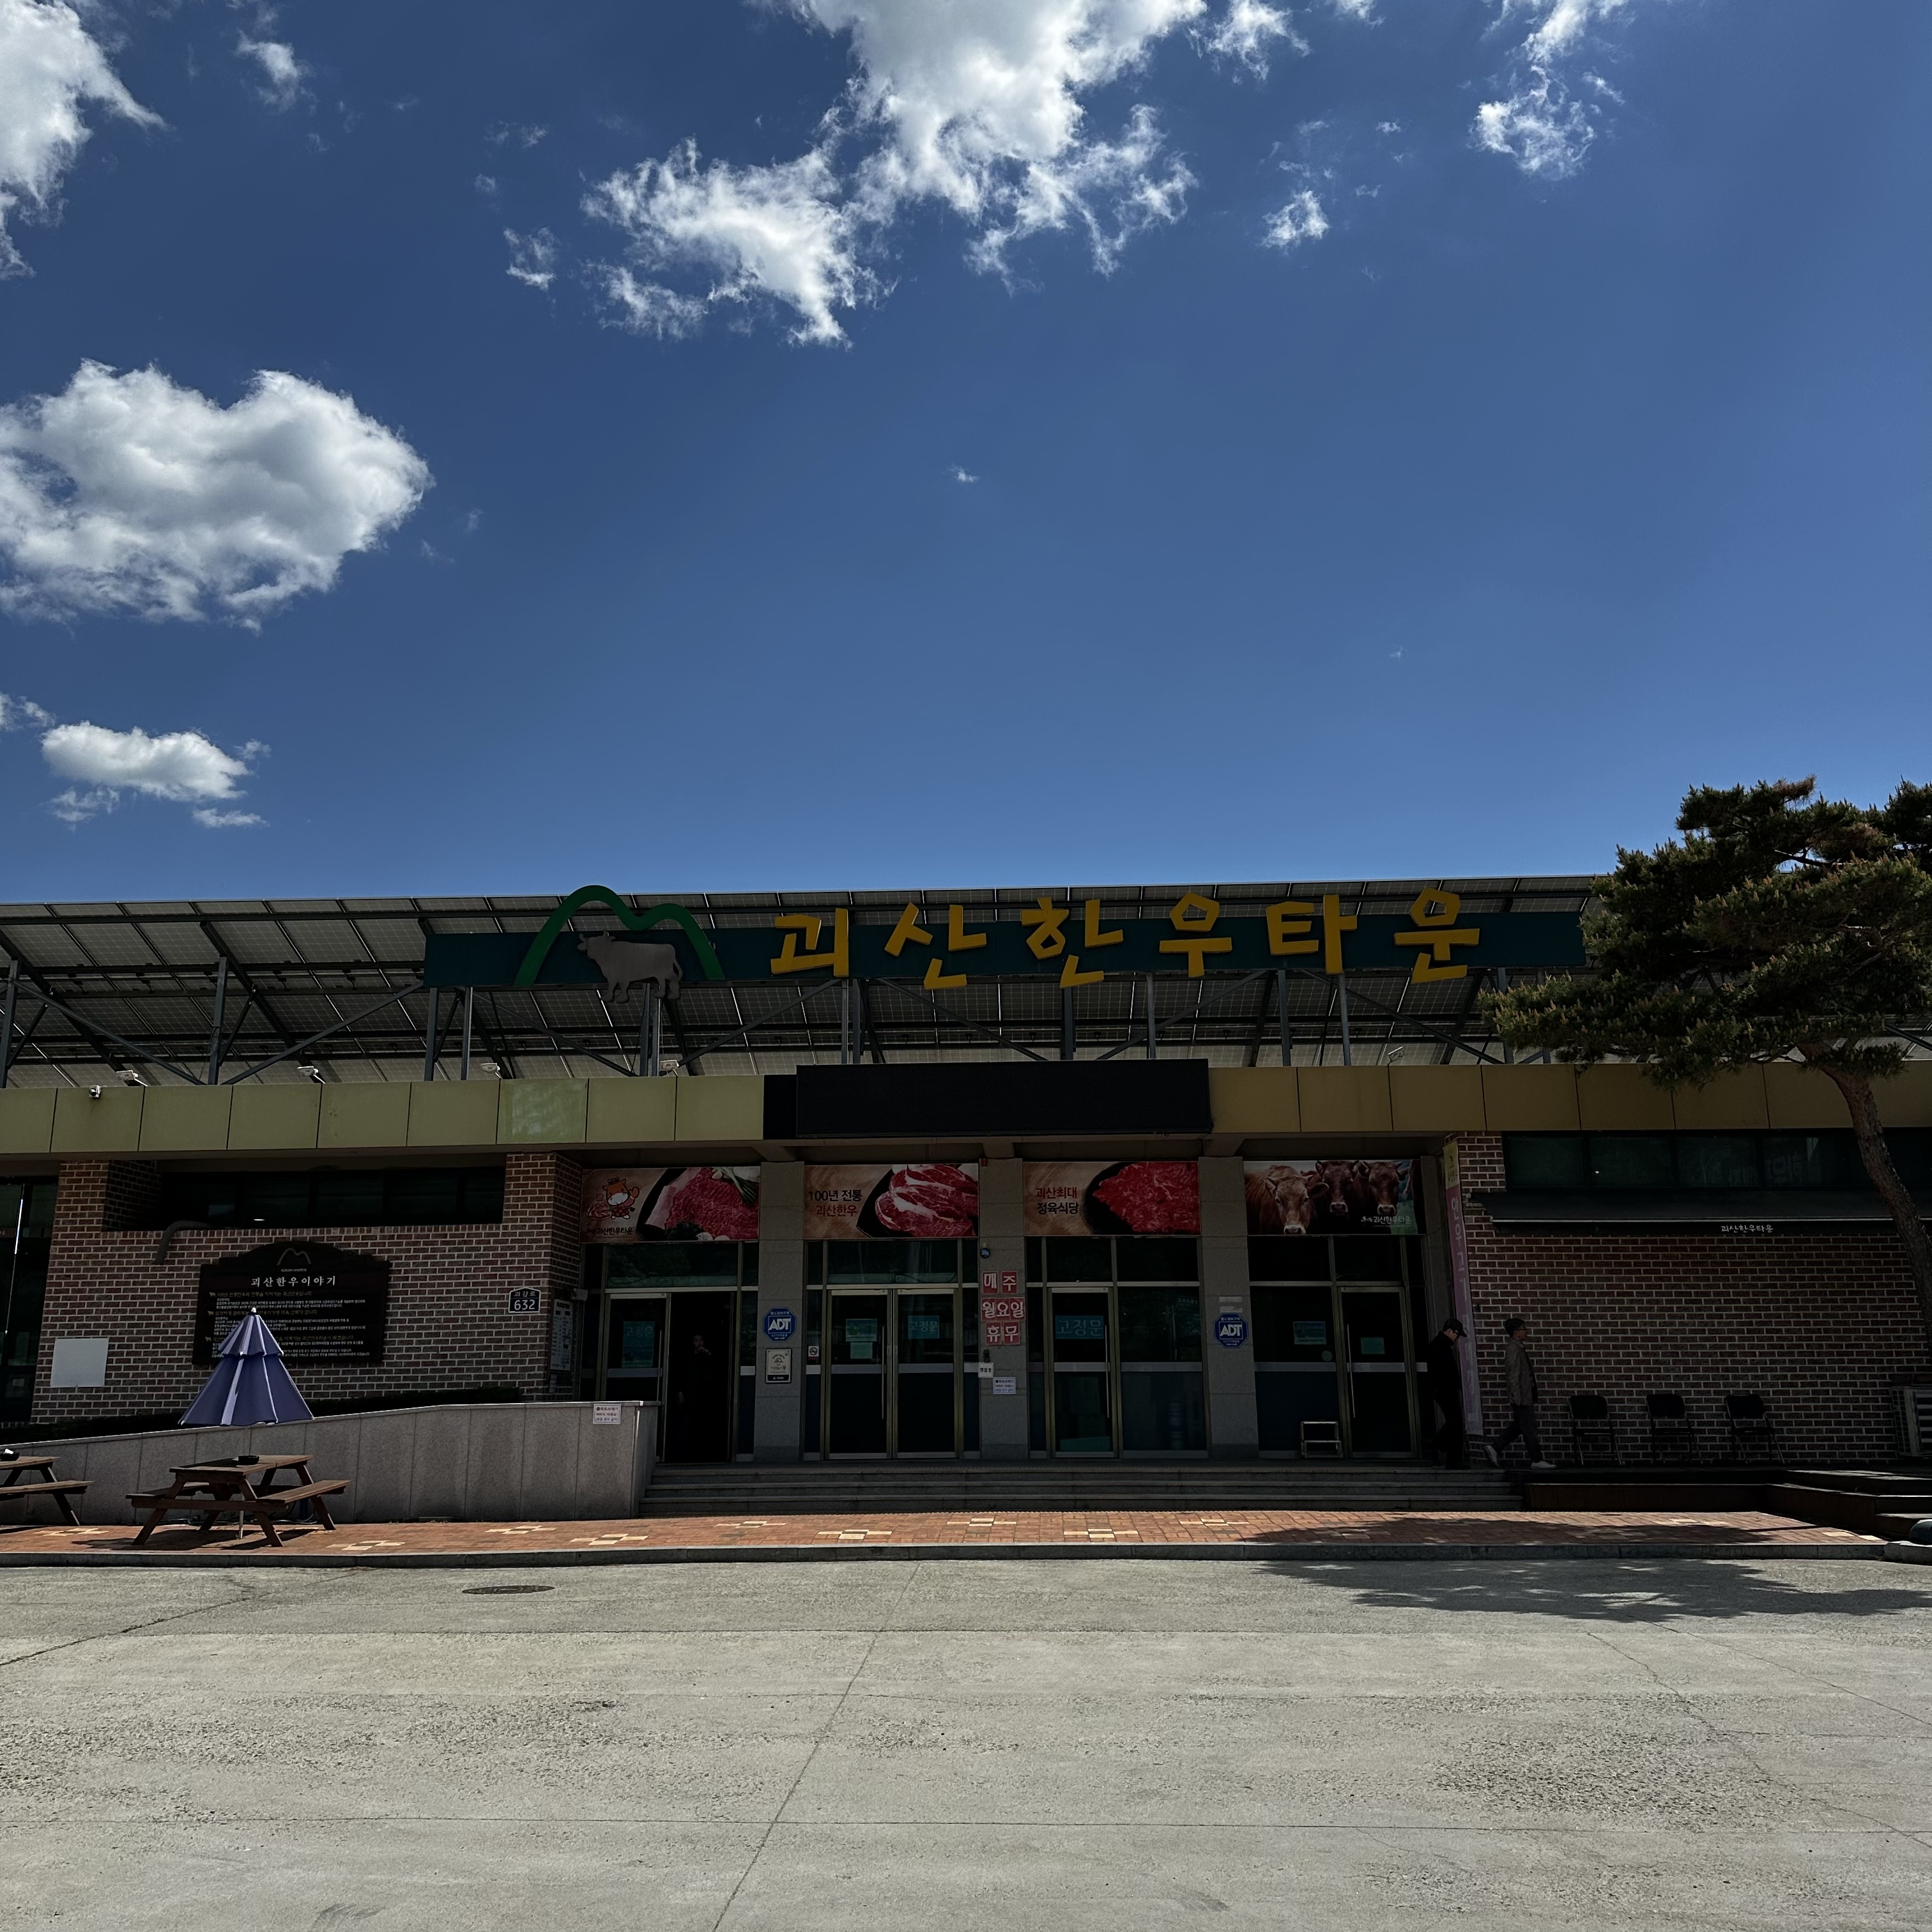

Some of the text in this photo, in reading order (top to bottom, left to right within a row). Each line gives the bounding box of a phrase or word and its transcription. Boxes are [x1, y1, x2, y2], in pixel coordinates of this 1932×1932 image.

[770, 887, 1480, 989] 괴산한우타운
[808, 1189, 862, 1202] 100년 전통
[1036, 1186, 1077, 1199] 괴산최대
[816, 1204, 857, 1217] 괴산한우
[1036, 1202, 1079, 1215] 정육식당
[1720, 1224, 1774, 1233] 괴산한우타운
[984, 1273, 1016, 1292] 매주
[514, 1299, 535, 1310] 632
[982, 1301, 1024, 1319] 월요일
[769, 1318, 792, 1330] ADT
[909, 1321, 939, 1332] 고정문
[1056, 1319, 1104, 1337] 고정문
[1220, 1324, 1243, 1337] ADT
[986, 1325, 1019, 1342] 휴무
